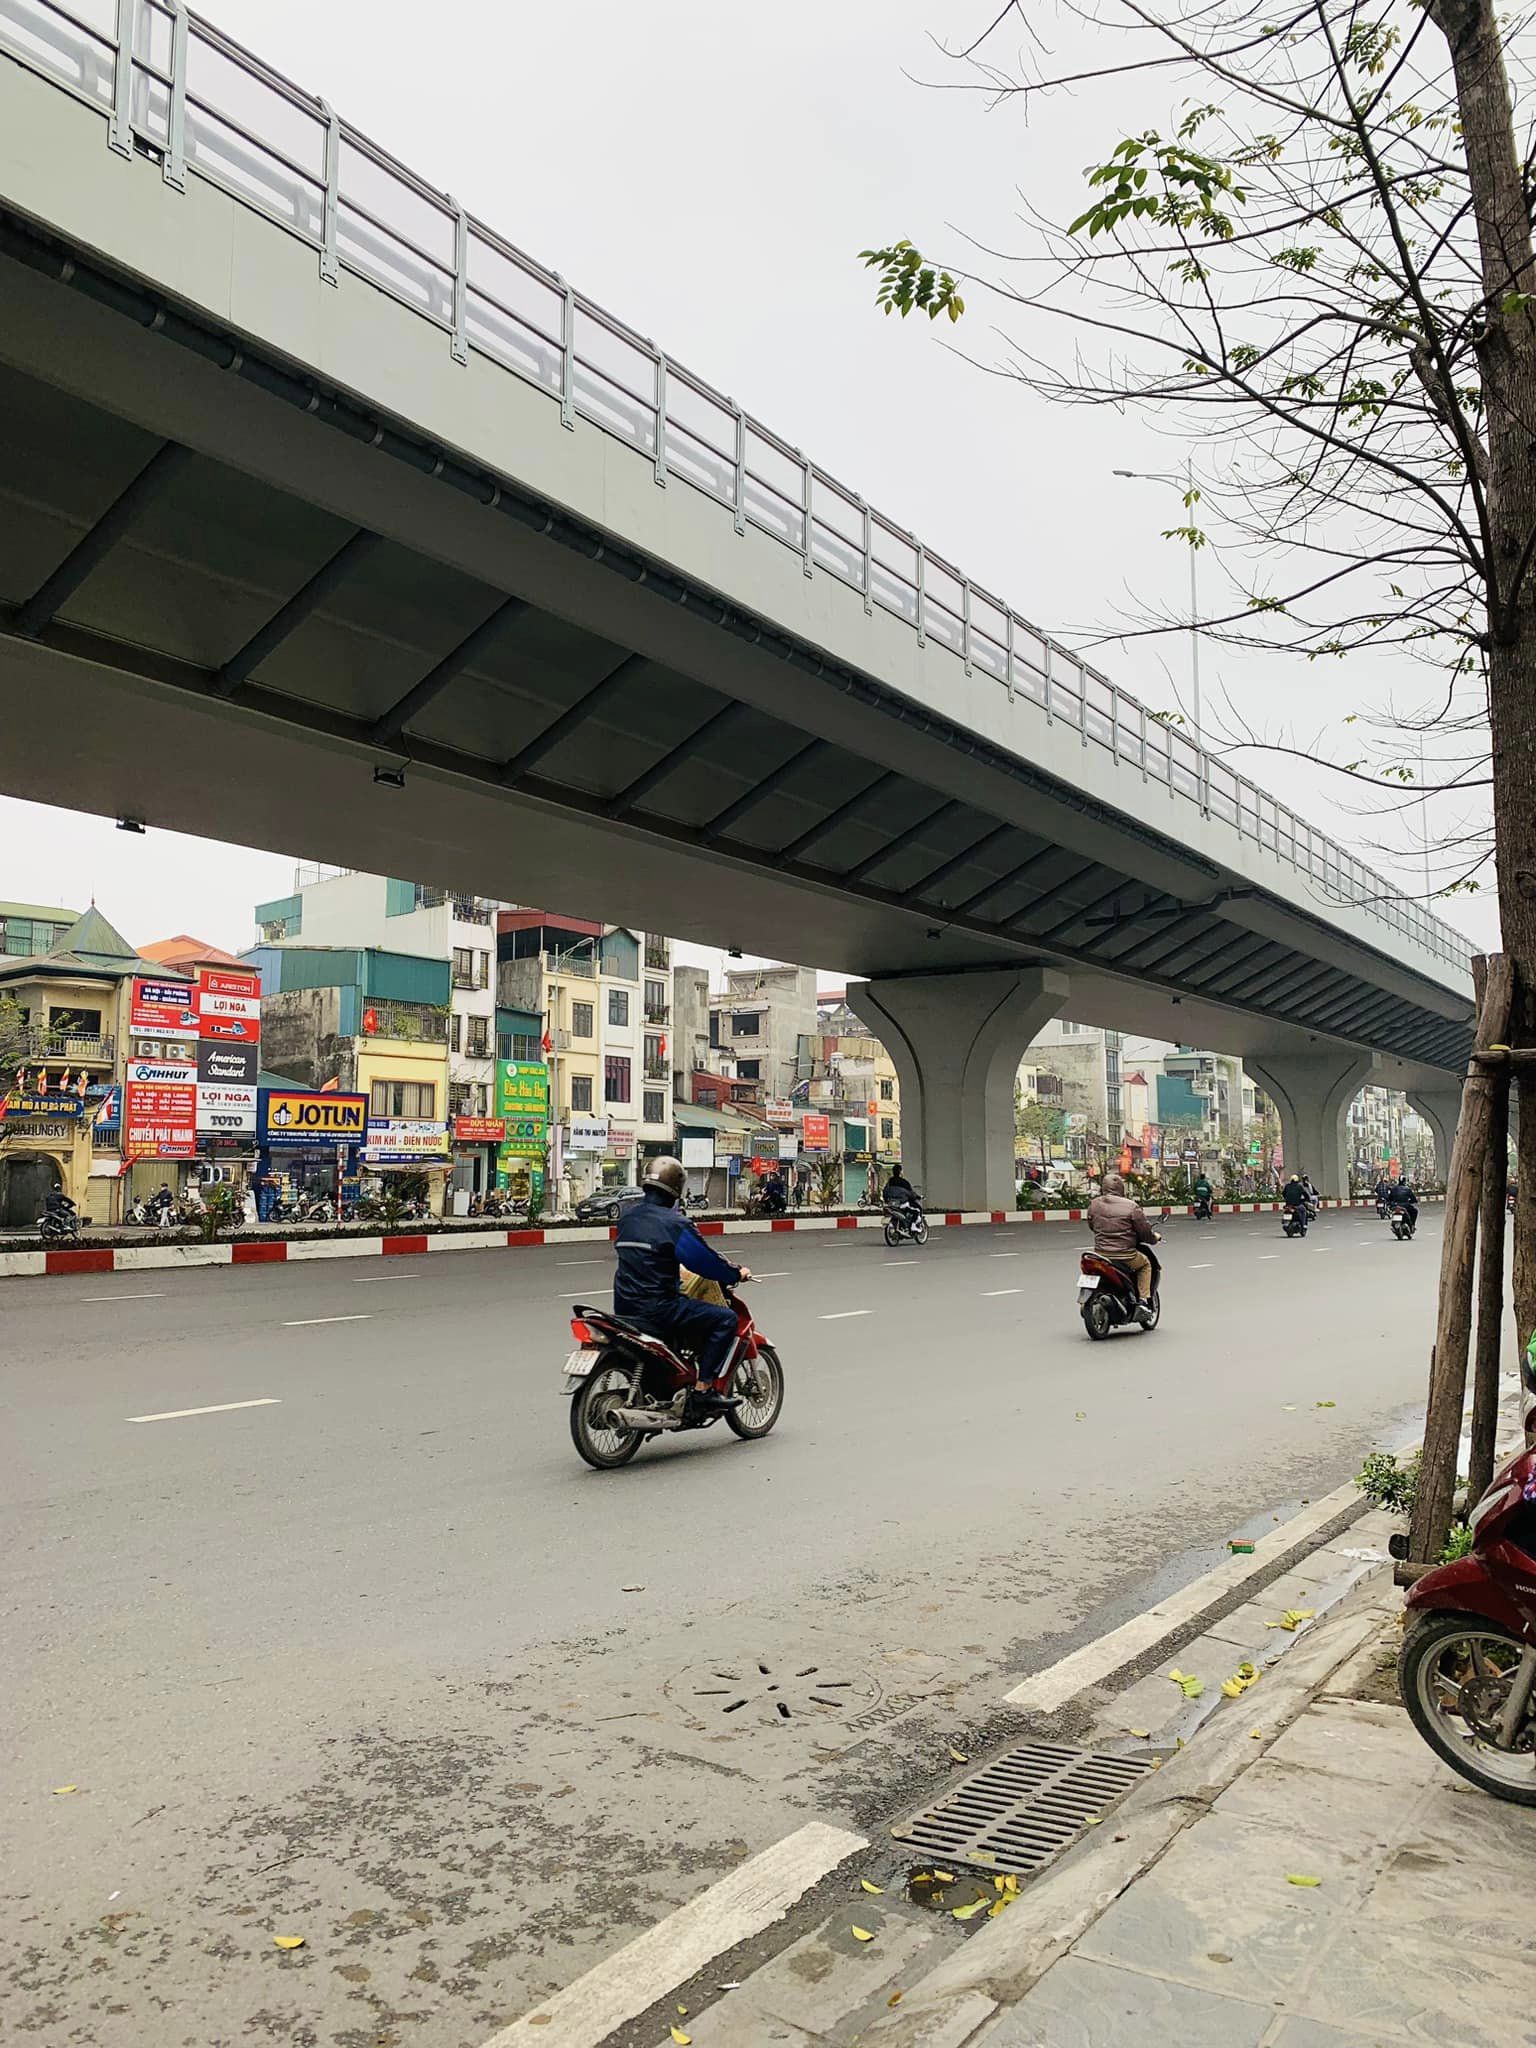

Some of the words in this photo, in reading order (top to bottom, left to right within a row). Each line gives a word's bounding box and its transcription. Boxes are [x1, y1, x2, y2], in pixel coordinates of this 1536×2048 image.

[229, 1001, 246, 1012] NGA
[208, 1051, 246, 1064] American
[208, 1064, 245, 1077] Standard
[202, 1092, 221, 1102] LỢI
[225, 1093, 251, 1102] NGA
[210, 1115, 243, 1126] TOTO
[295, 1104, 360, 1126] JOTUN
[507, 1122, 542, 1137] OCOP
[367, 1135, 381, 1145] KIM
